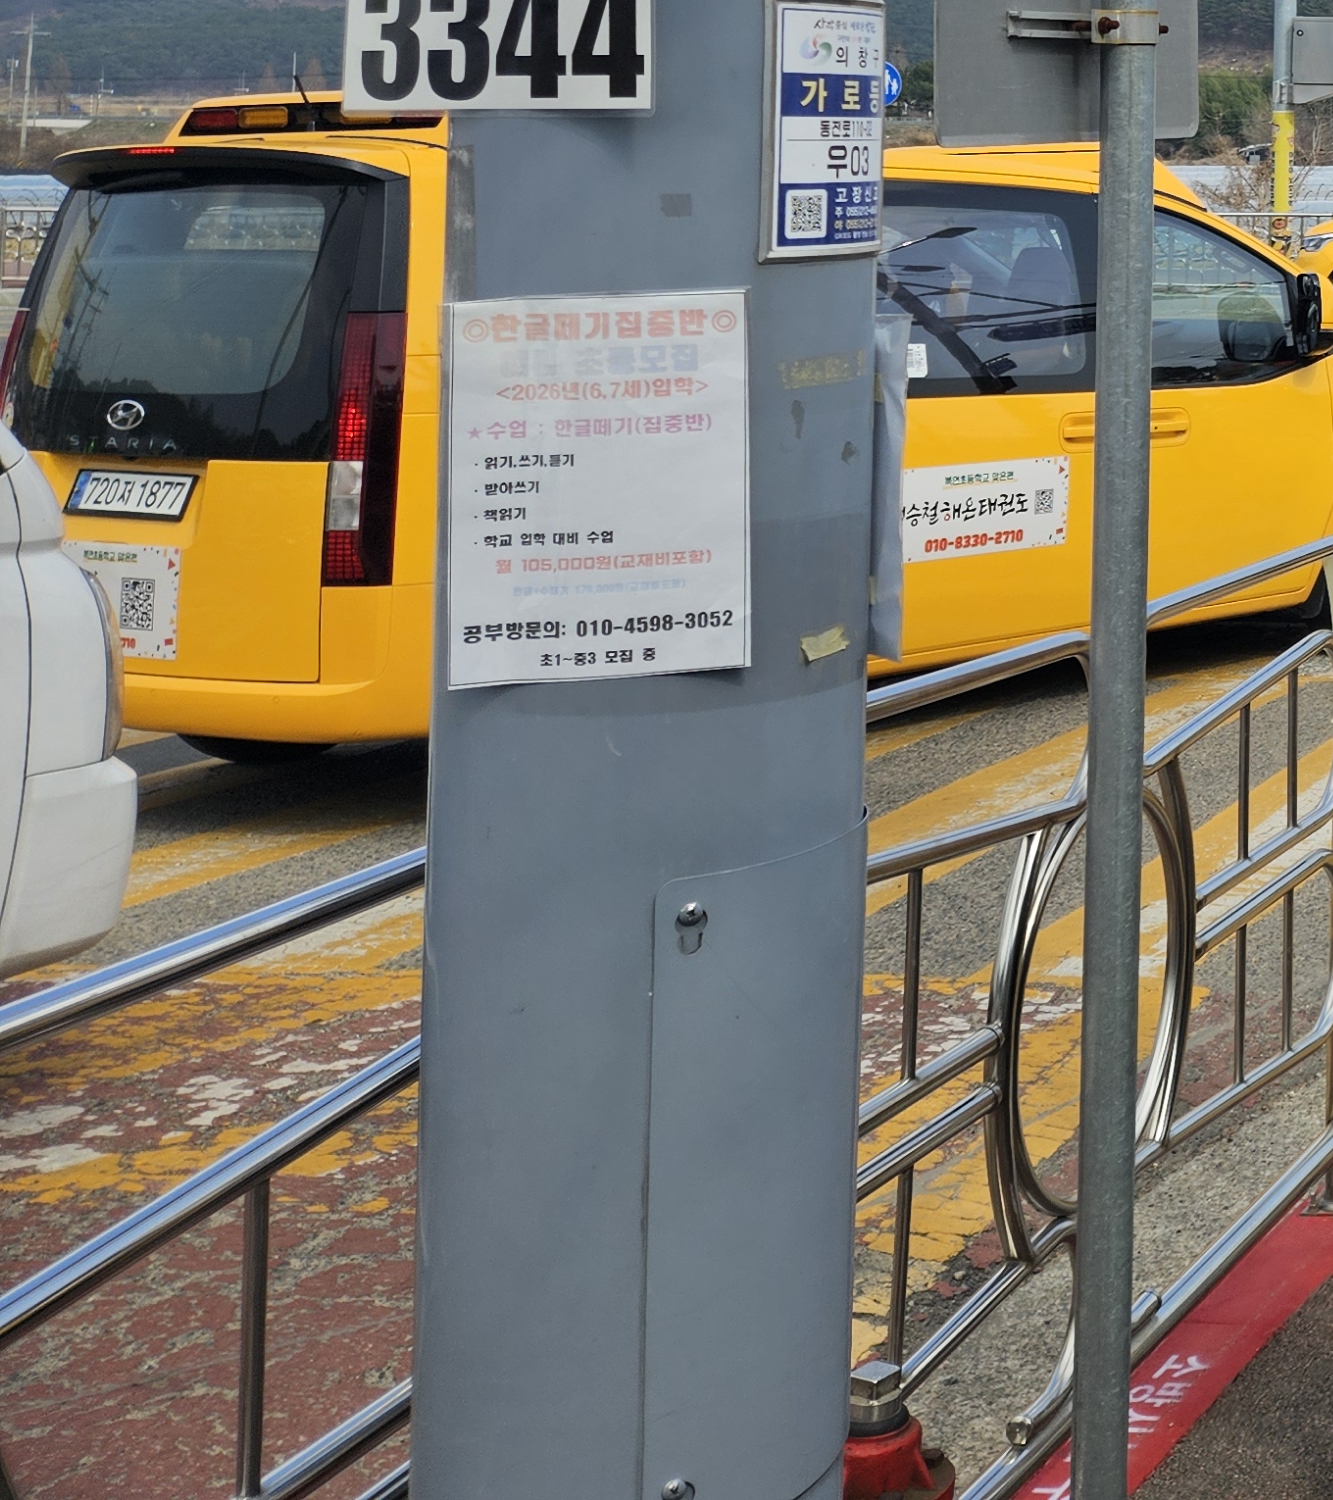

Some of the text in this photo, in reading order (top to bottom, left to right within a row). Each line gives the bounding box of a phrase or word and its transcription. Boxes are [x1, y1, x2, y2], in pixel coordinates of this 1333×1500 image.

[826, 144, 871, 179] 우03
[69, 433, 178, 451] STARIA
[83, 476, 187, 510] 720저 1877
[484, 480, 540, 497] 받아쓰기
[483, 507, 527, 523] 책읽기
[483, 530, 614, 548] 학교 입학 대비 수업
[923, 528, 1025, 554] 010-8330-2710
[463, 609, 735, 645] 공부방문의: 010-4598-3052
[604, 649, 634, 665] 모집
[641, 647, 657, 661] 중
